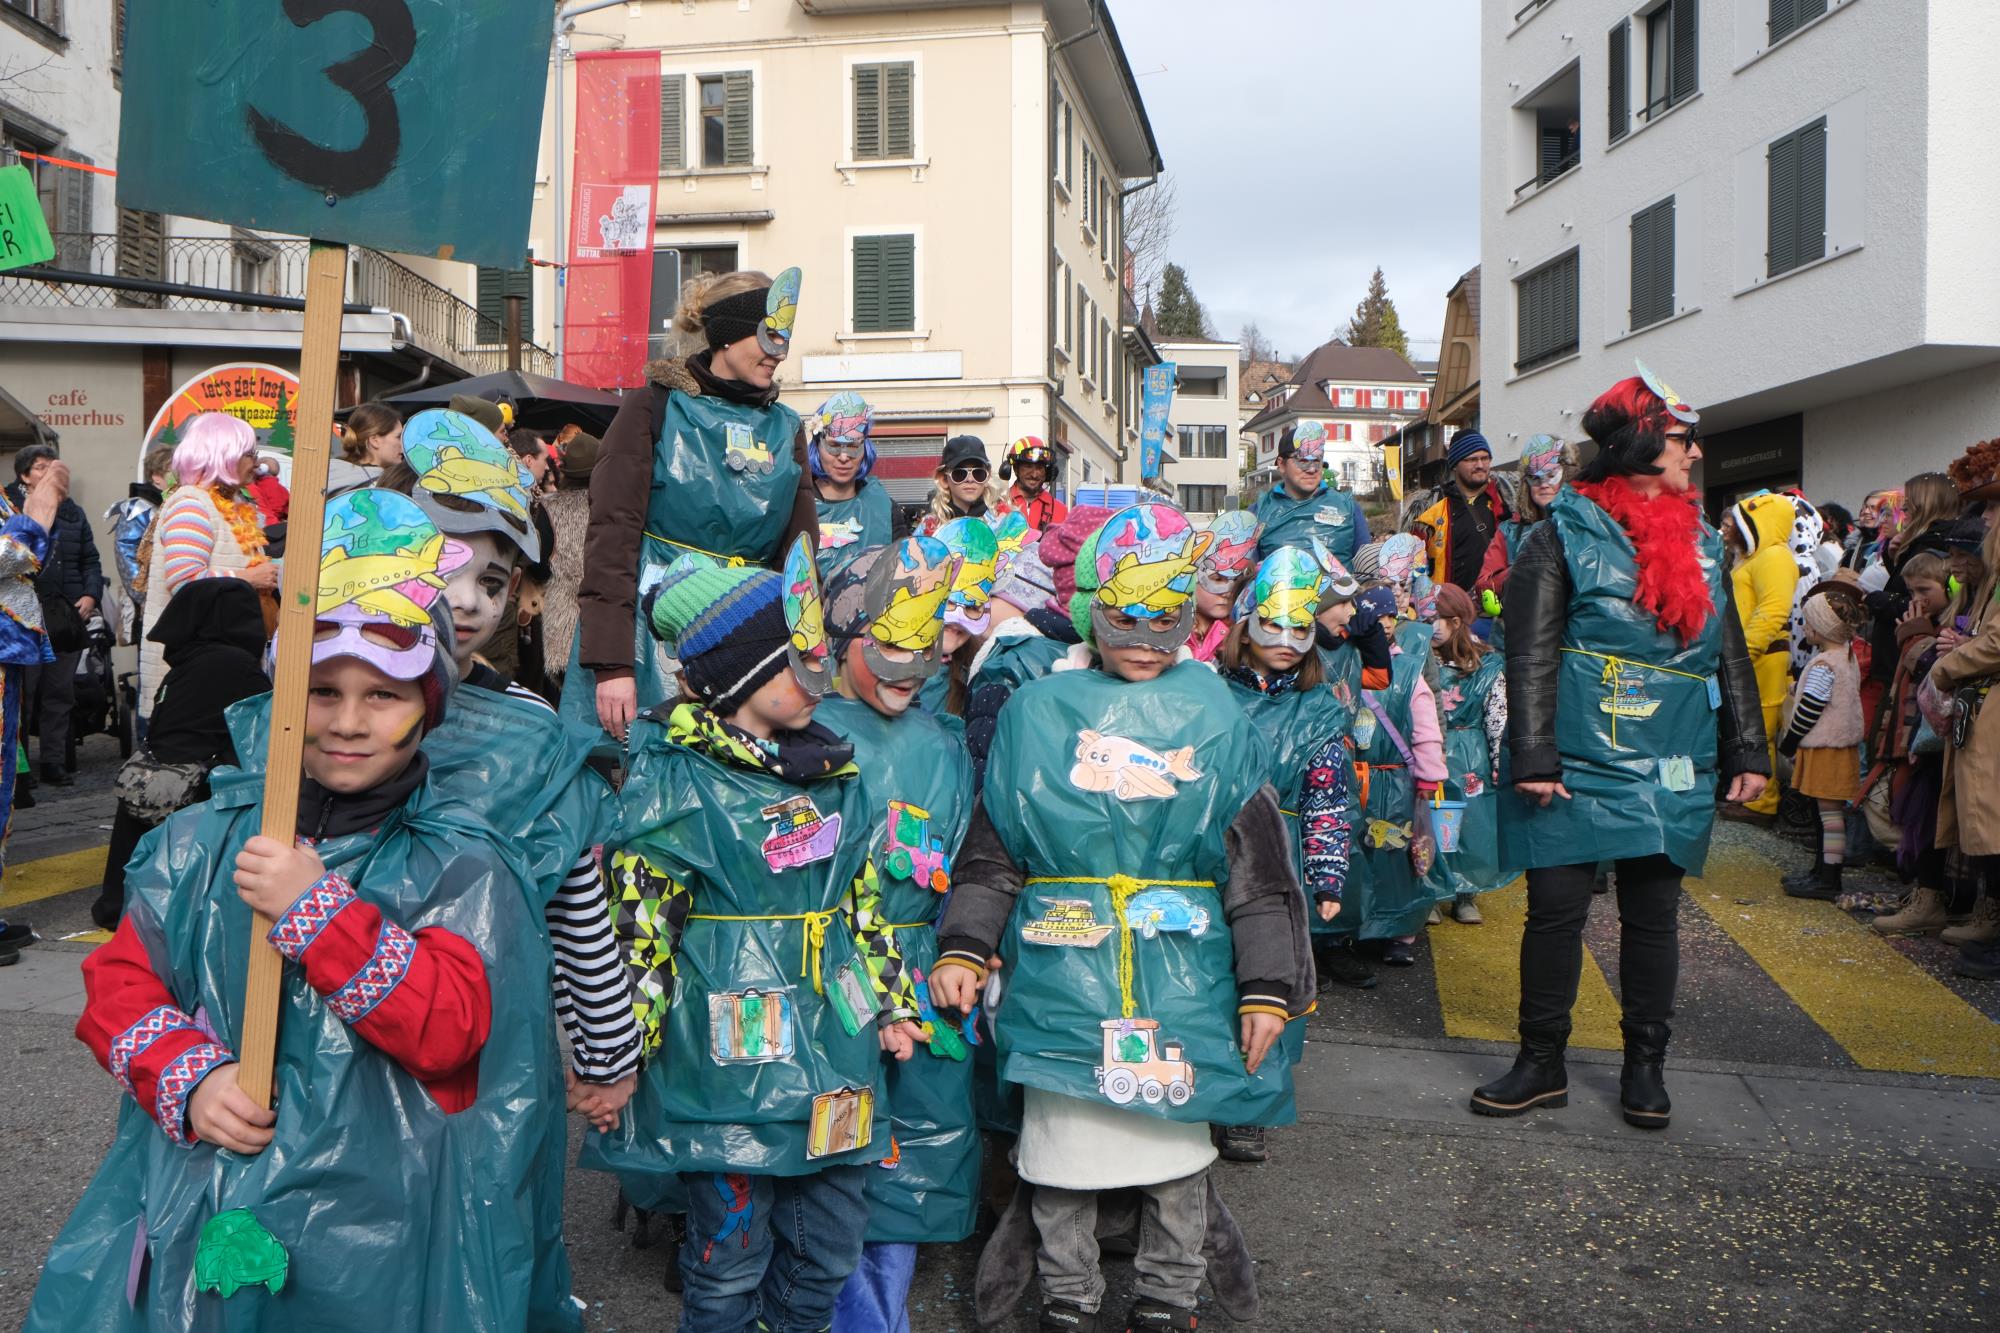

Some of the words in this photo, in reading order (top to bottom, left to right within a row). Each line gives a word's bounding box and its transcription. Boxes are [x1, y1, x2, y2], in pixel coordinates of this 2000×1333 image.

[246, 0, 417, 196] 3
[234, 375, 256, 397] get
[48, 389, 88, 406] café
